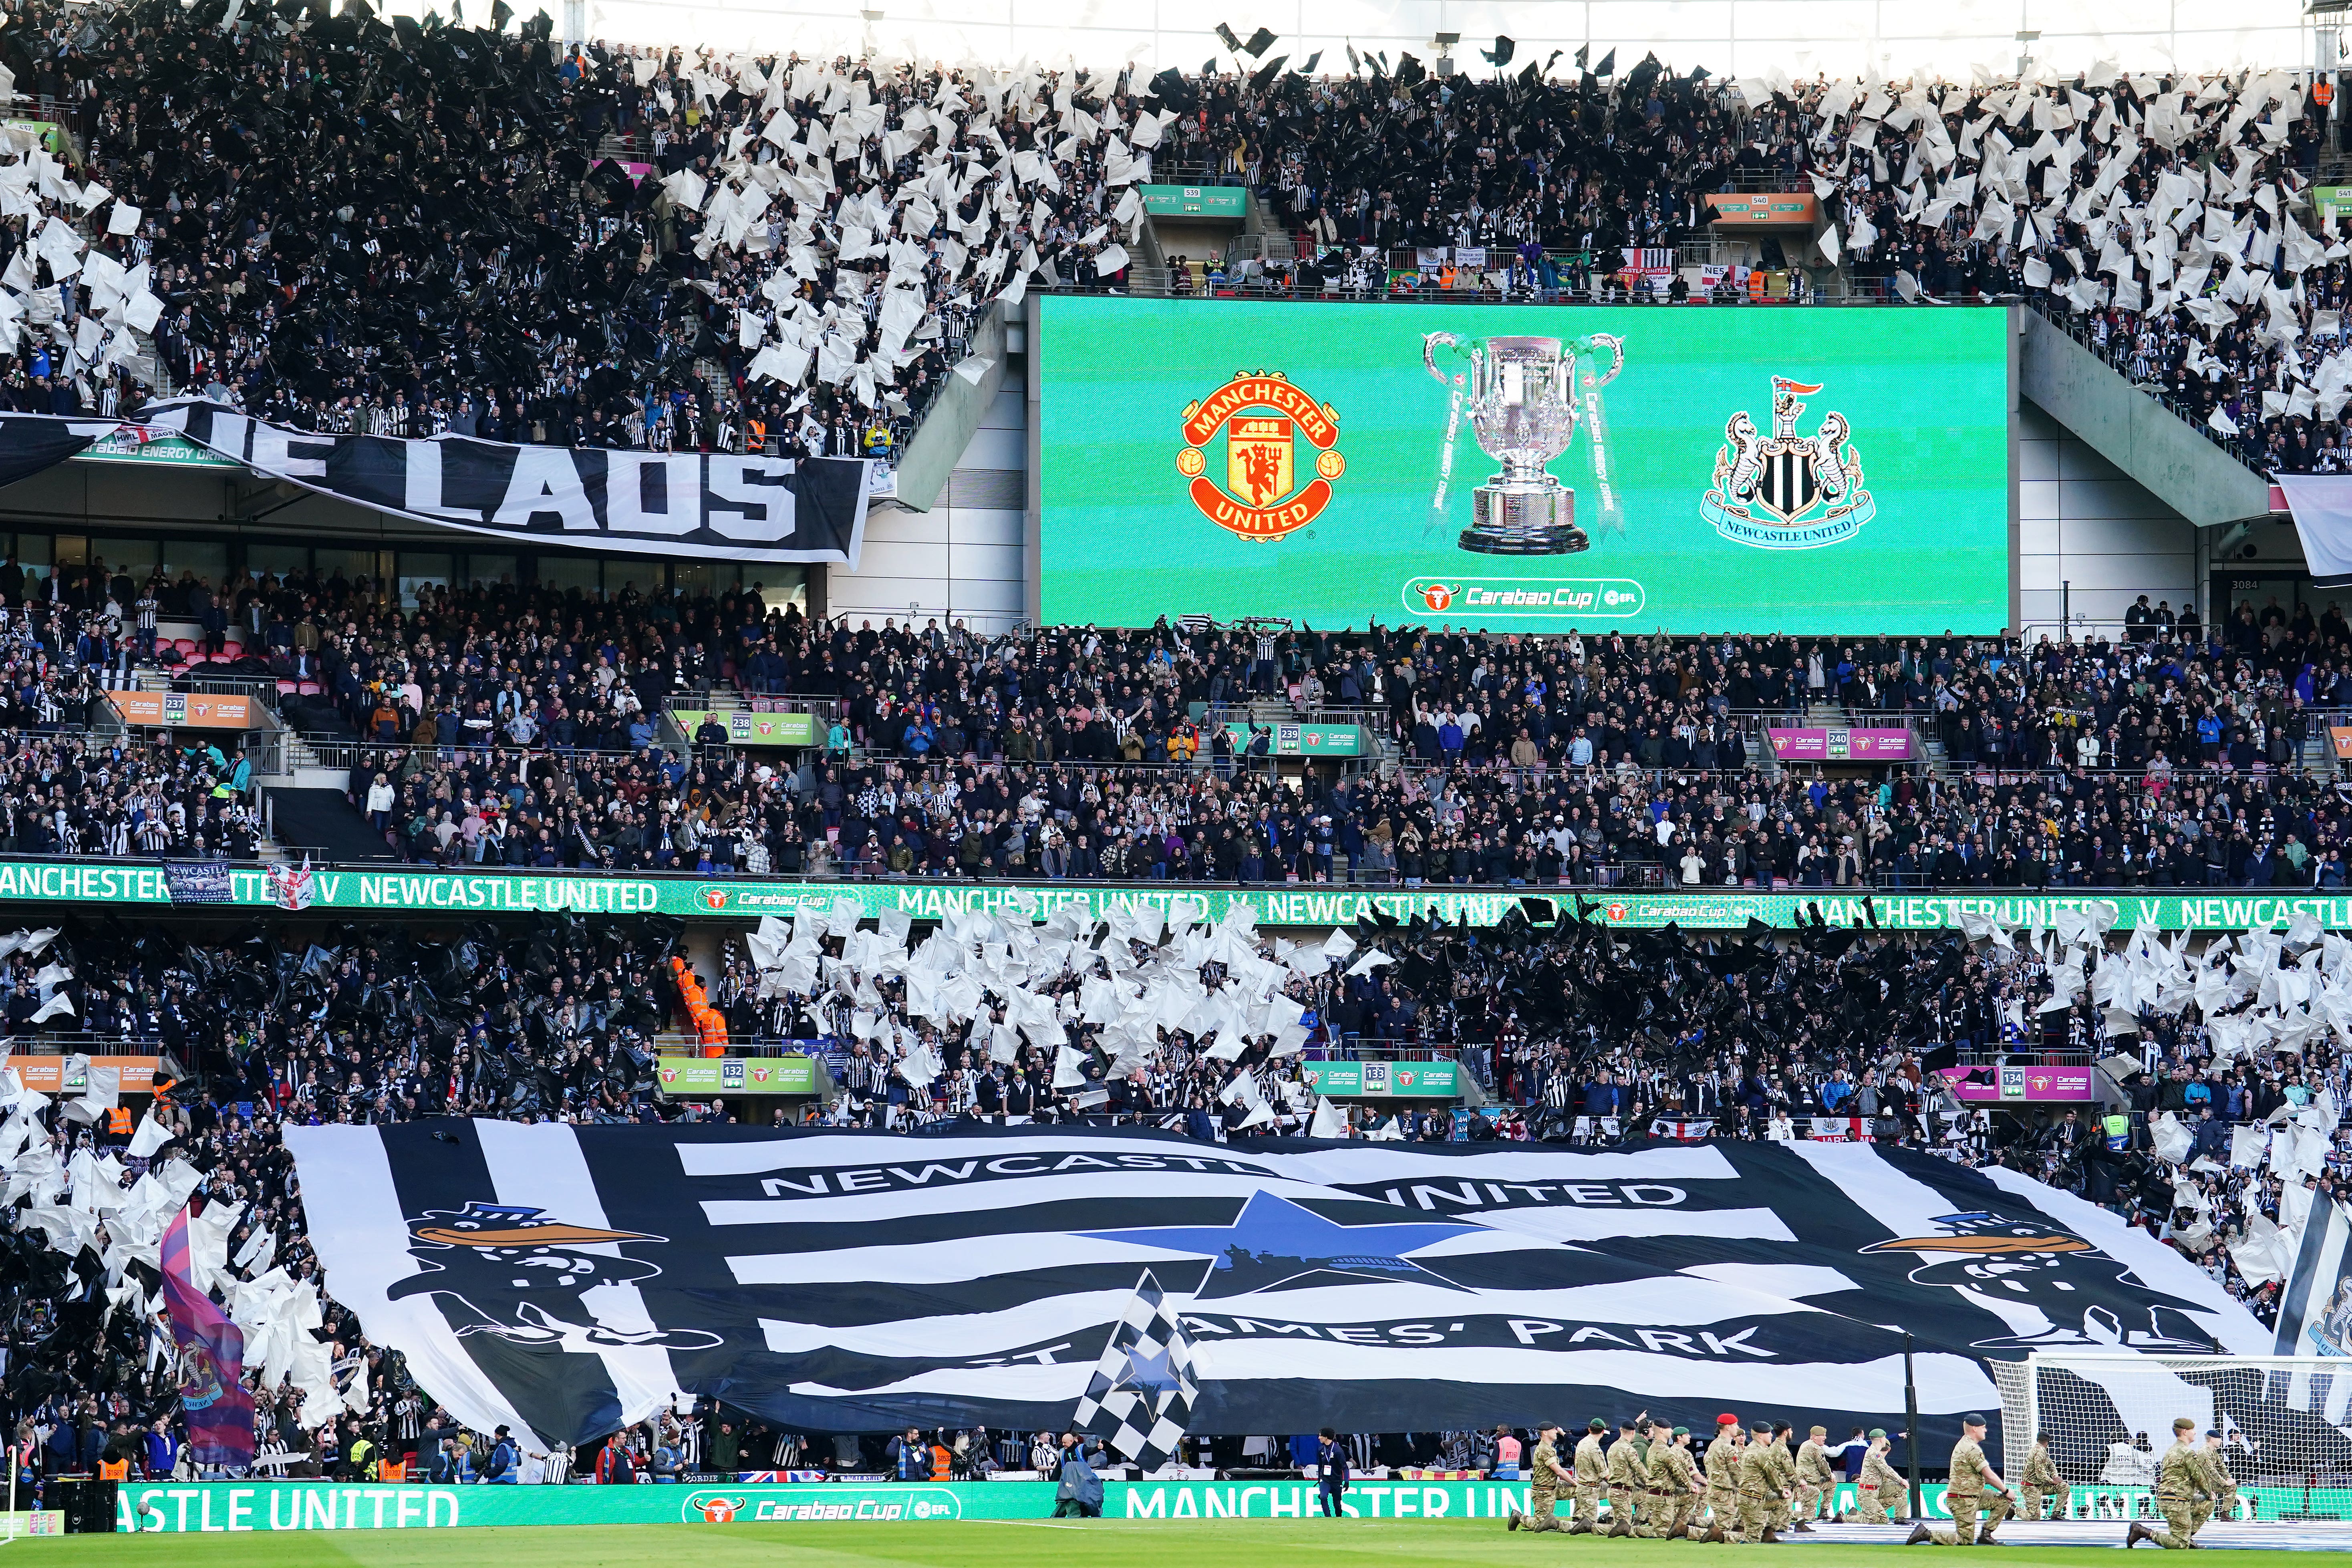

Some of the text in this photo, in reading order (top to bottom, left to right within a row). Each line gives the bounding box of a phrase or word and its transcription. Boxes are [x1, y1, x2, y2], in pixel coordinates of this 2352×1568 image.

[1194, 383, 1327, 439] MANCHESTER
[151, 431, 173, 439] MAGS
[81, 440, 139, 456] rabao
[141, 445, 194, 459] ENERGY
[404, 439, 795, 542] LADS
[1216, 501, 1308, 531] UNITED
[1724, 520, 1851, 542] NEWCASTLE UNITED
[2232, 580, 2258, 589] 3084
[1465, 587, 1636, 610] Carabao Cup EFL
[166, 699, 184, 709] 237
[733, 719, 750, 728] 238
[1281, 730, 1298, 738] 239
[1830, 734, 1847, 743] 240
[165, 864, 228, 875] NEWCASTLE
[0, 866, 171, 899] ANCHESTER
[322, 875, 339, 903] V
[360, 876, 537, 908] NEWCASTLE
[546, 880, 658, 910] UNITED
[737, 892, 827, 908] Carabao Cup
[1638, 904, 1698, 917] Carabao
[1698, 905, 1727, 919] Cup
[2139, 900, 2161, 925] V
[2181, 899, 2352, 926] NEWCASTL
[724, 1066, 742, 1076] 132
[1367, 1069, 1384, 1079] 133
[2004, 1073, 2022, 1083] 134
[759, 1154, 1277, 1198] NEWCASTL
[1182, 1315, 1464, 1345] AMES'
[1506, 1319, 1779, 1358] PARK
[117, 1488, 459, 1532] ASTLE UNITED
[754, 1501, 950, 1520] Carabao Cup EFL
